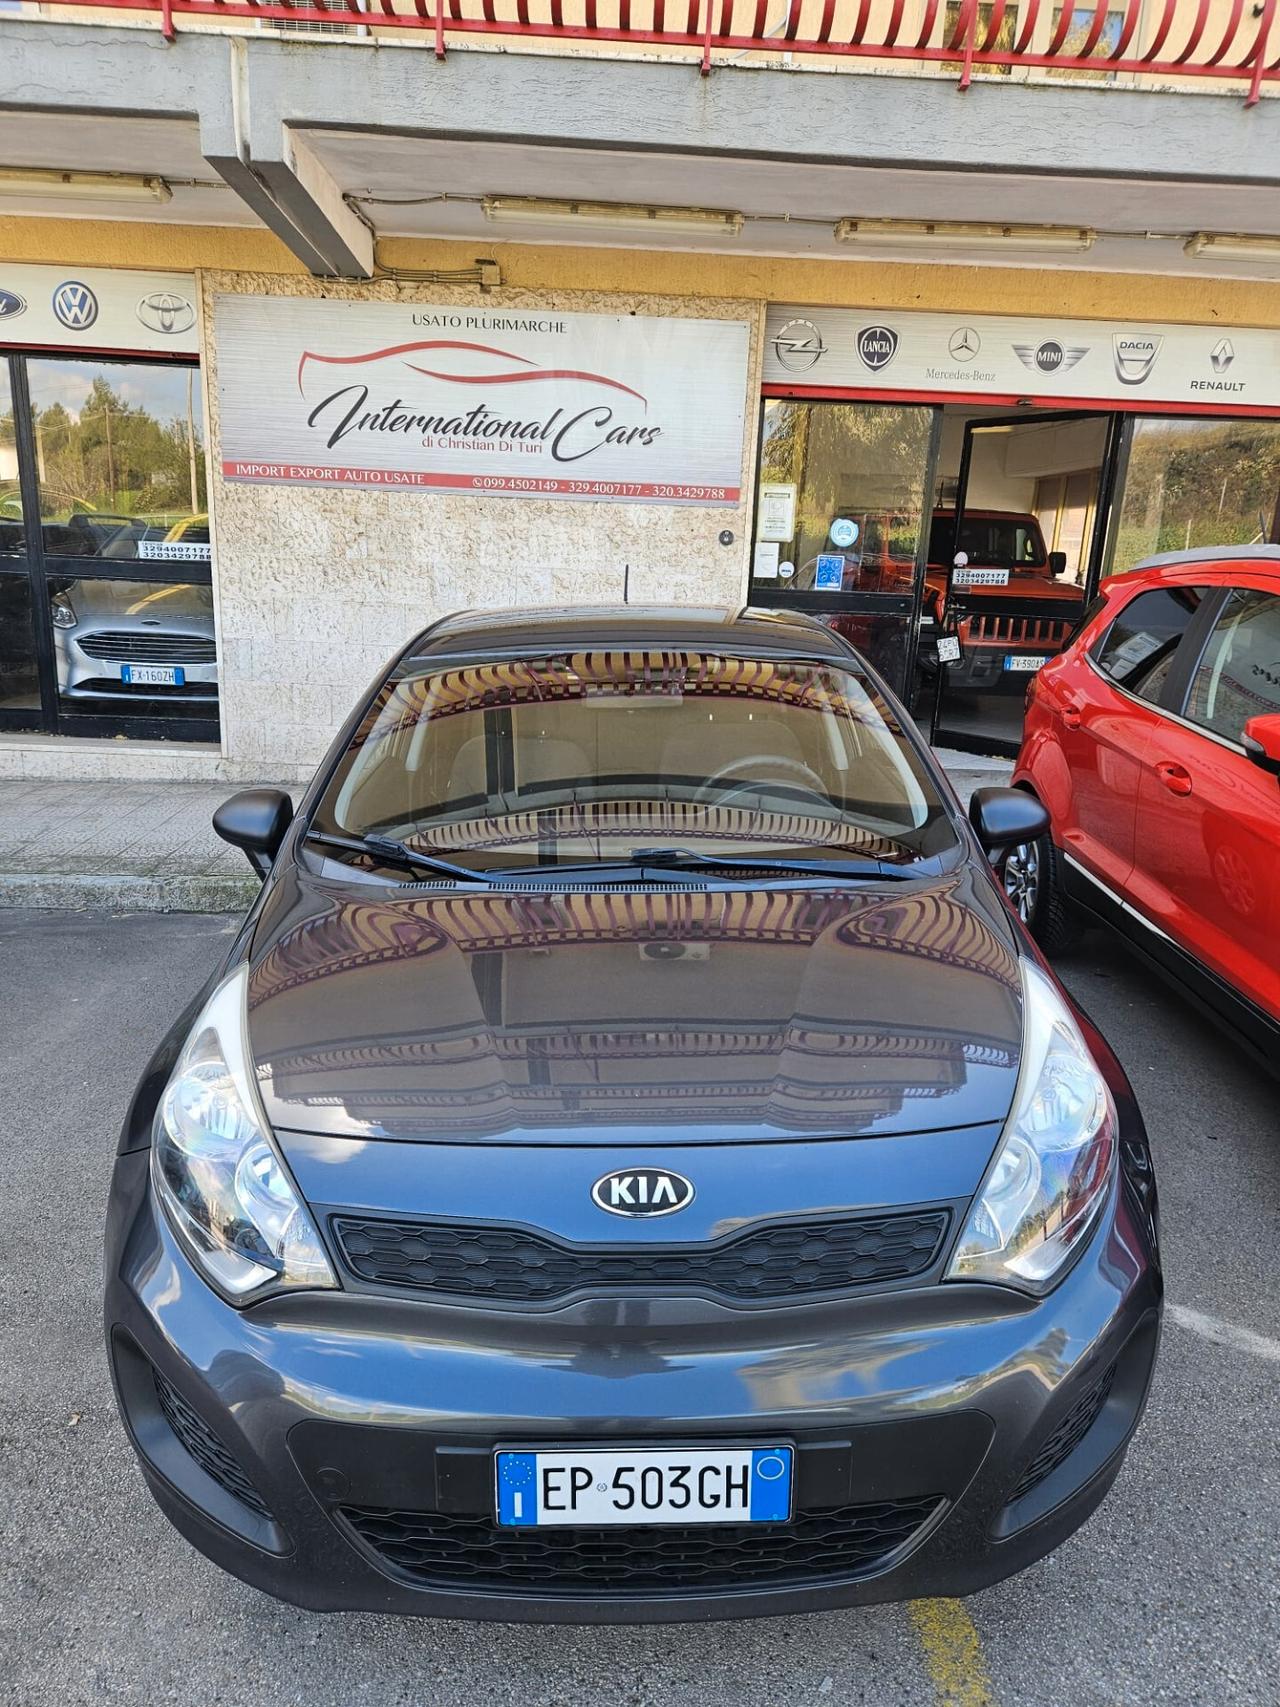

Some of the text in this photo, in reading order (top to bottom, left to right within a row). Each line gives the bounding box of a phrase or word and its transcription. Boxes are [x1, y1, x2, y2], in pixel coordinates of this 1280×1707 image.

[412, 313, 568, 334] USATO PLURIMARCHE
[863, 340, 891, 353] LANCIA
[1119, 341, 1154, 351] DACIA
[1037, 351, 1062, 363] MINI
[925, 368, 997, 382] Mercedes-Benz
[1190, 380, 1247, 392] RENAULT
[307, 384, 665, 462] International Cars
[421, 436, 543, 454] di Christian Di Turi
[236, 464, 425, 485] IMPORT EXPORT AUTO USATE
[483, 478, 558, 492] 099.4502149
[568, 482, 642, 496] 329.4007177
[651, 486, 726, 500] 320.3429788
[609, 1176, 678, 1205] KIA
